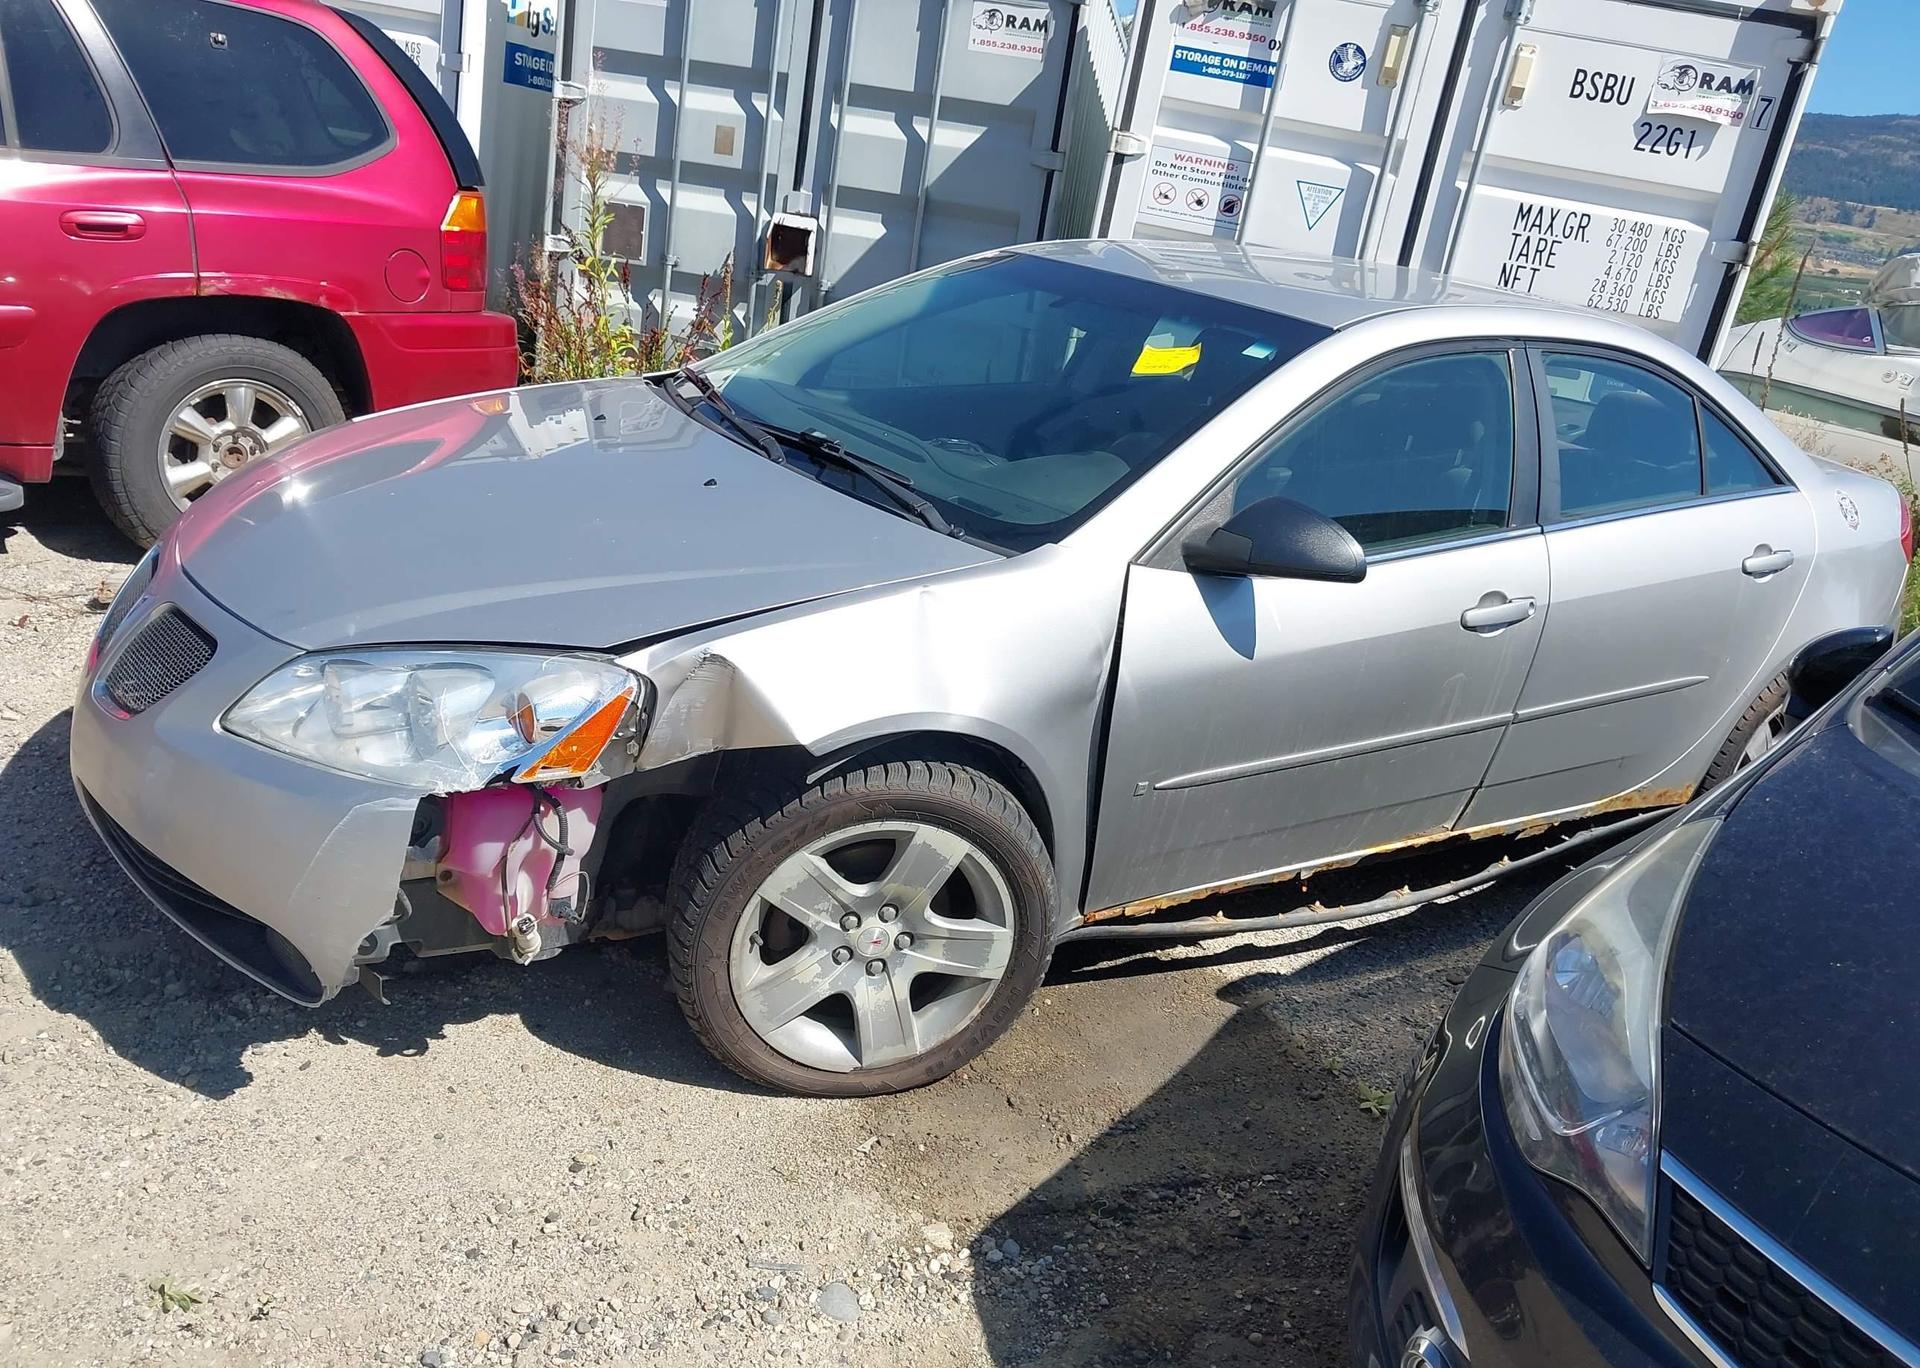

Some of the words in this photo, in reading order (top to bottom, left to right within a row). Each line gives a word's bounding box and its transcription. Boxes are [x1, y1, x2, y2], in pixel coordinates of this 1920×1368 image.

[1005, 14, 1048, 33] RAM
[972, 38, 1044, 54] 1.855.238.9350
[1175, 49, 1222, 66] STORAGE
[1222, 57, 1238, 69] ON
[1569, 68, 1635, 106] BSBU
[1698, 73, 1755, 96] RAM
[1756, 98, 1773, 128] 7
[1633, 121, 1697, 159] 22G1
[1154, 160, 1168, 168] Do
[1169, 162, 1188, 172] Not
[1190, 166, 1216, 177] Store
[1218, 171, 1240, 181] Fuel
[1174, 153, 1239, 172] WARNING:
[1151, 168, 1179, 179] Other
[1181, 174, 1248, 192] Combustibles
[1662, 226, 1687, 244] KGS
[1508, 232, 1562, 269] TARE
[1657, 242, 1682, 260] LBS
[1652, 257, 1677, 275] KGS
[1647, 272, 1672, 290] LBS
[1642, 287, 1667, 305] KGS
[1638, 302, 1662, 320] LBS
